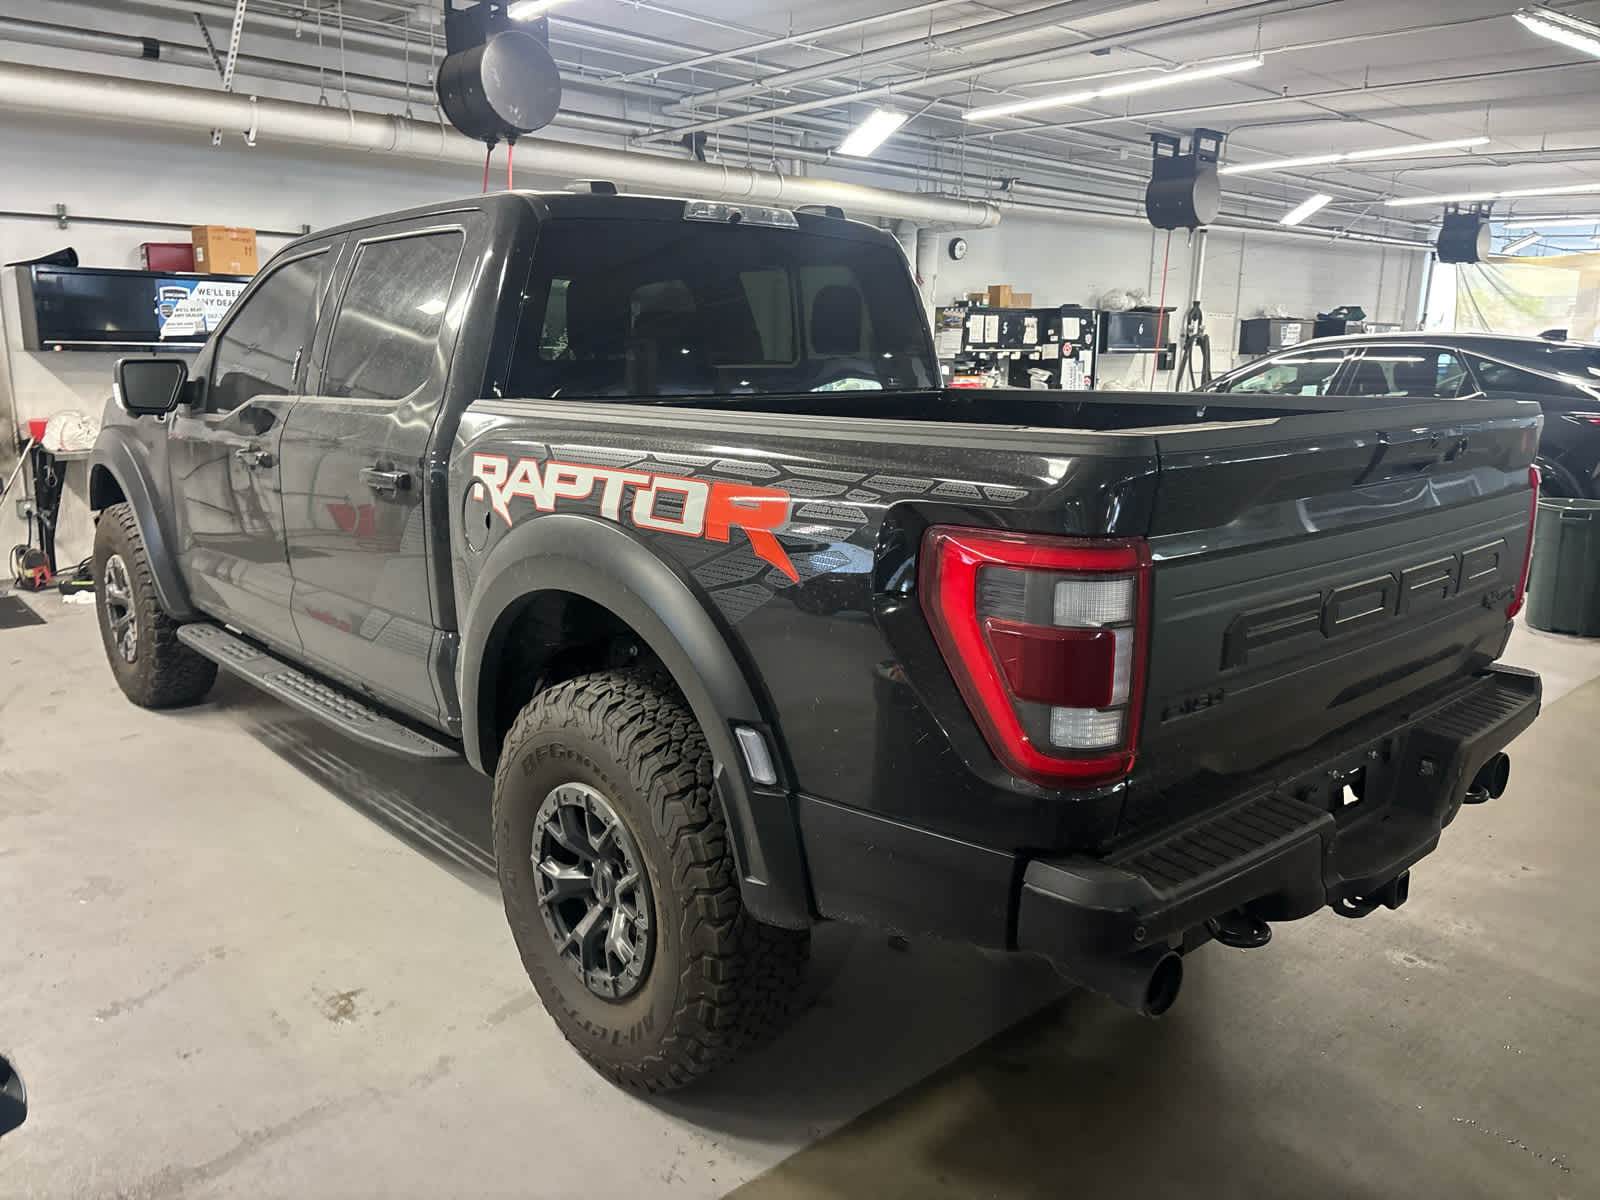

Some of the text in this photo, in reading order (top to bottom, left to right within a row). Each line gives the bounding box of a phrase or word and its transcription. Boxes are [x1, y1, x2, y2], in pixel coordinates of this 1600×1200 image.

[1002, 321, 1008, 335] 5
[1138, 323, 1145, 336] 6
[471, 452, 800, 585] RAPTOR
[1219, 537, 1510, 673] FORD
